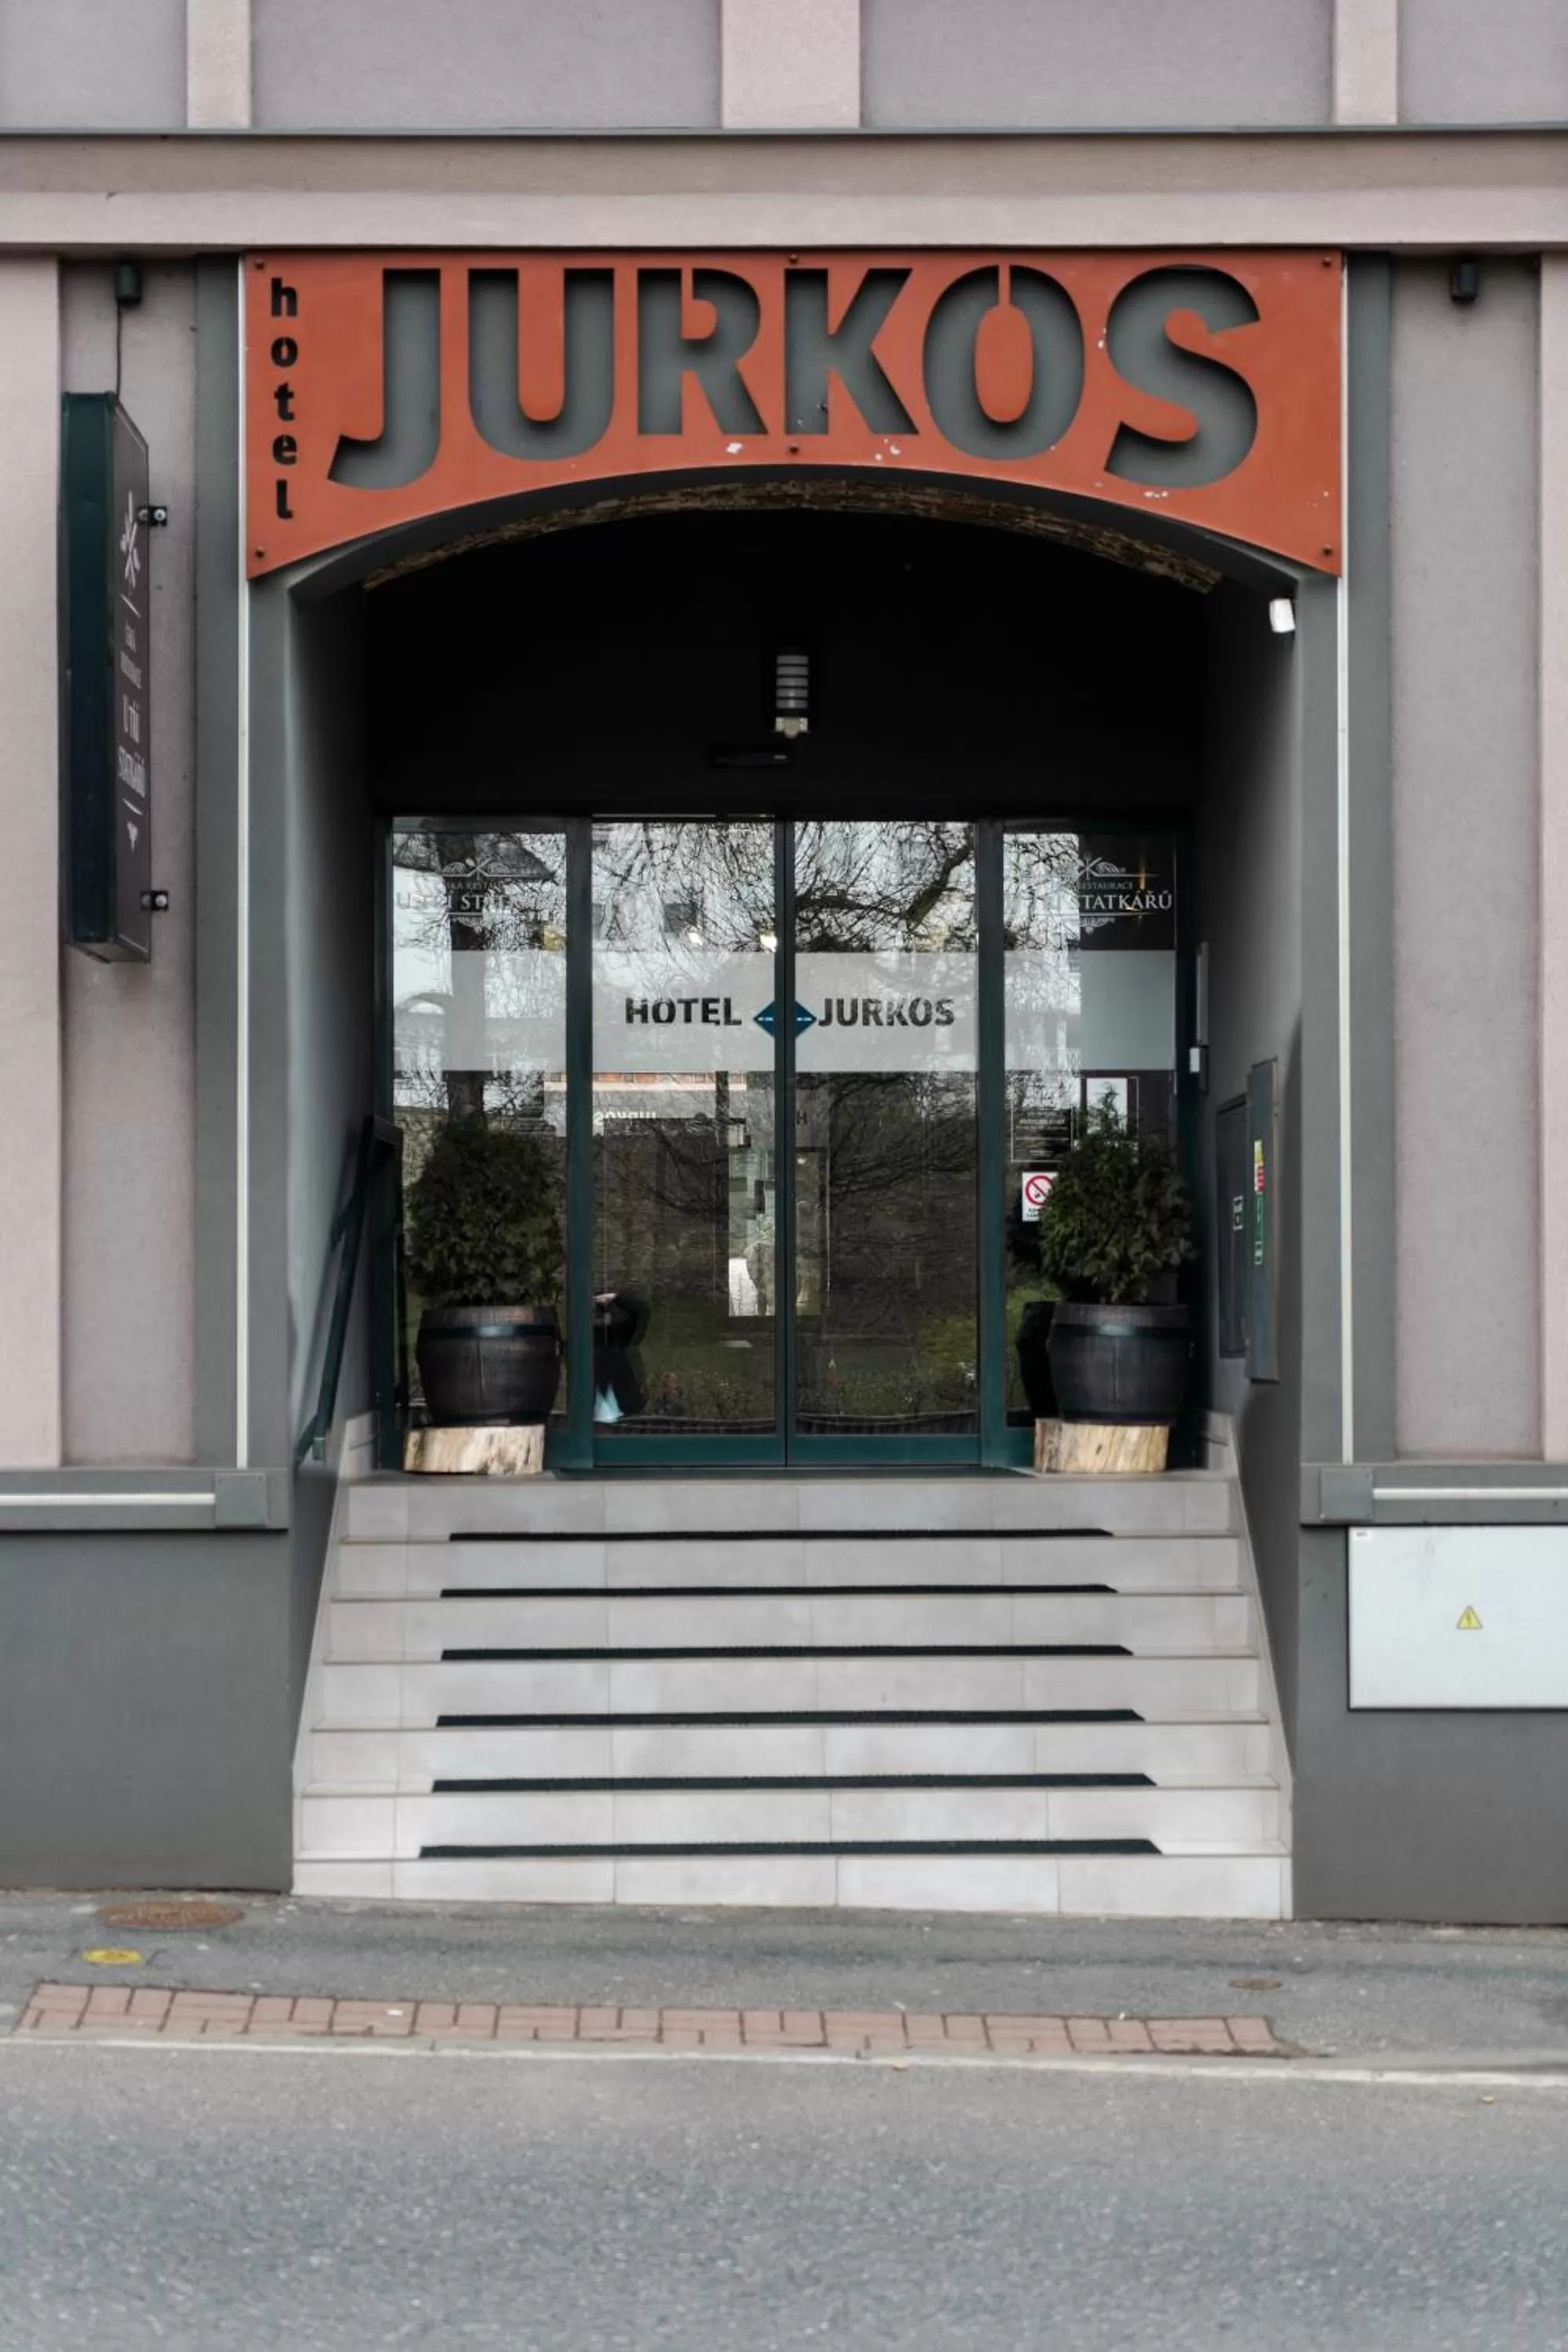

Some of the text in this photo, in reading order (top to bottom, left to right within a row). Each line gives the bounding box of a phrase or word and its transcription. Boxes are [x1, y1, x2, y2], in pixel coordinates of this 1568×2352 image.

[270, 277, 298, 521] hotel
[327, 263, 1261, 490] JURKOS
[1068, 890, 1173, 910] TATKÁŘŮ
[624, 997, 955, 1026] HOTEL JURKOS
